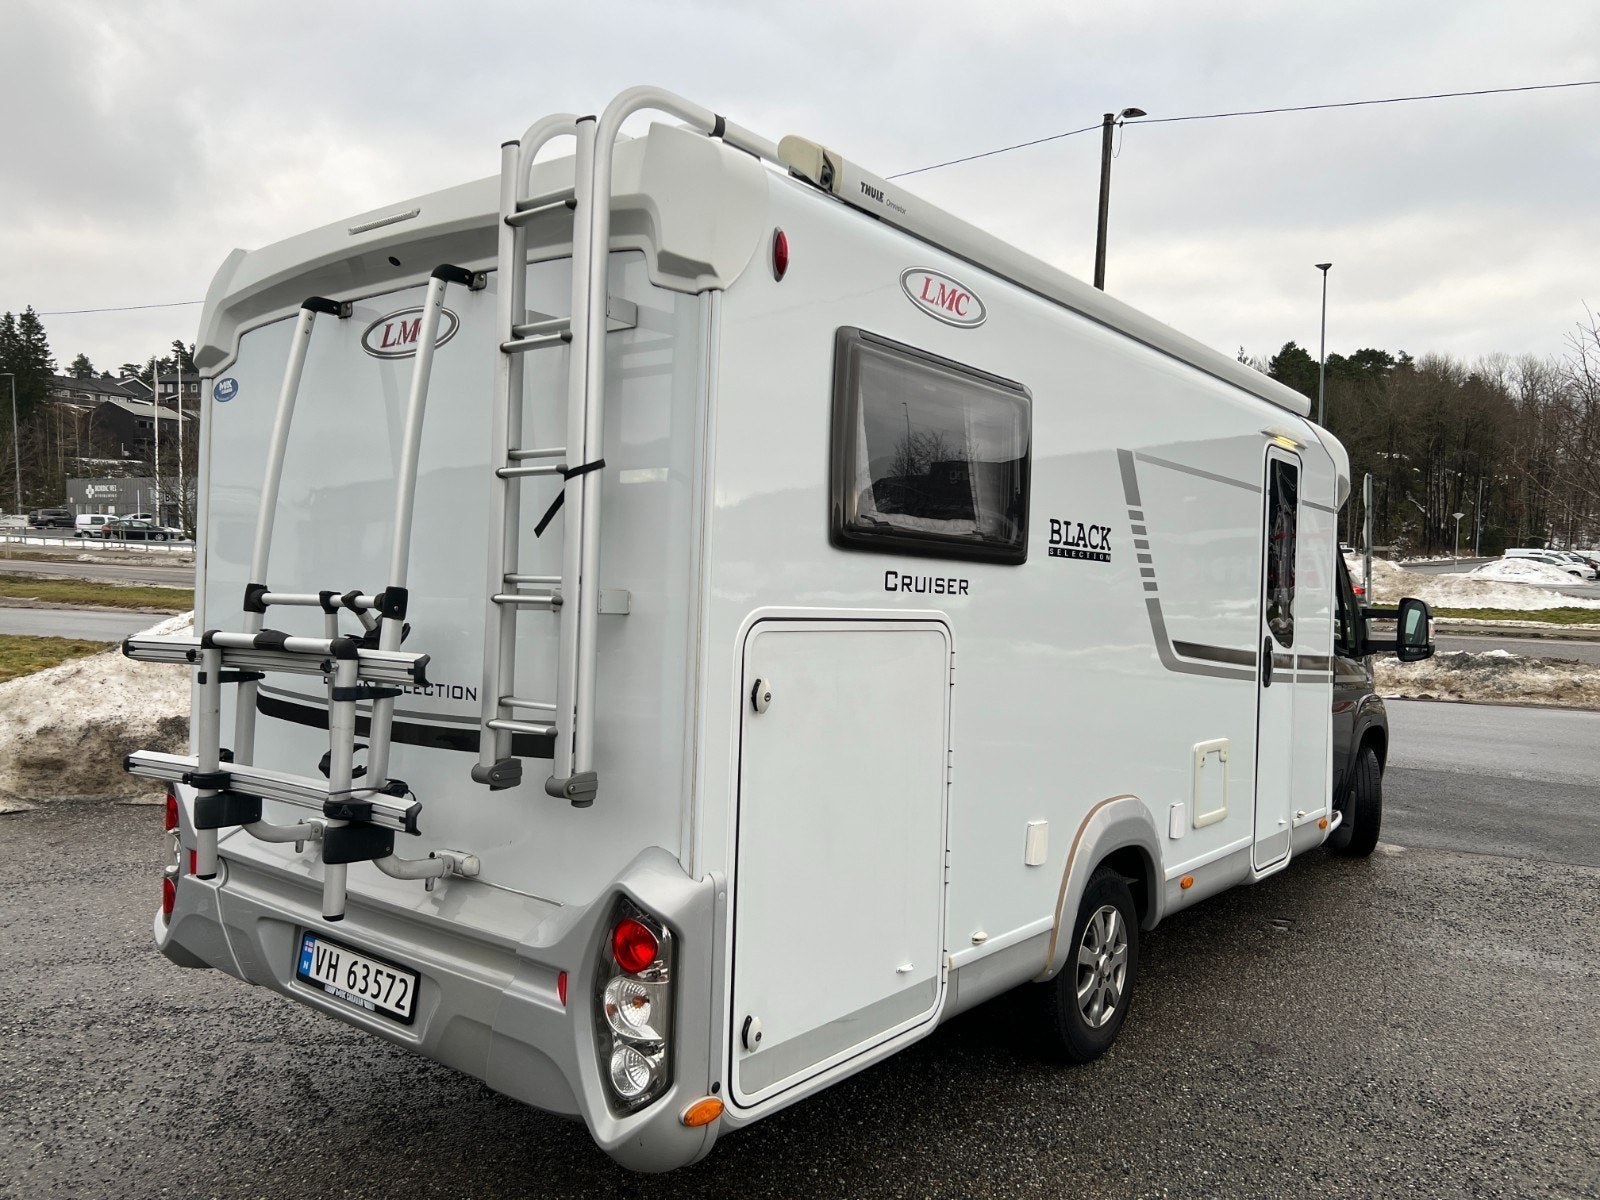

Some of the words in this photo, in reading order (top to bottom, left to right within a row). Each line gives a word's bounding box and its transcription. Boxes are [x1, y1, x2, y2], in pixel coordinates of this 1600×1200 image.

[860, 181, 884, 203] THULE
[920, 276, 971, 317] LMC
[380, 317, 423, 348] LM
[1048, 518, 1112, 551] BLACK
[1049, 547, 1111, 561] SELECTION
[395, 682, 477, 702] LECTION
[302, 960, 310, 971] N
[316, 946, 340, 983] VH
[347, 961, 409, 1010] 63572
